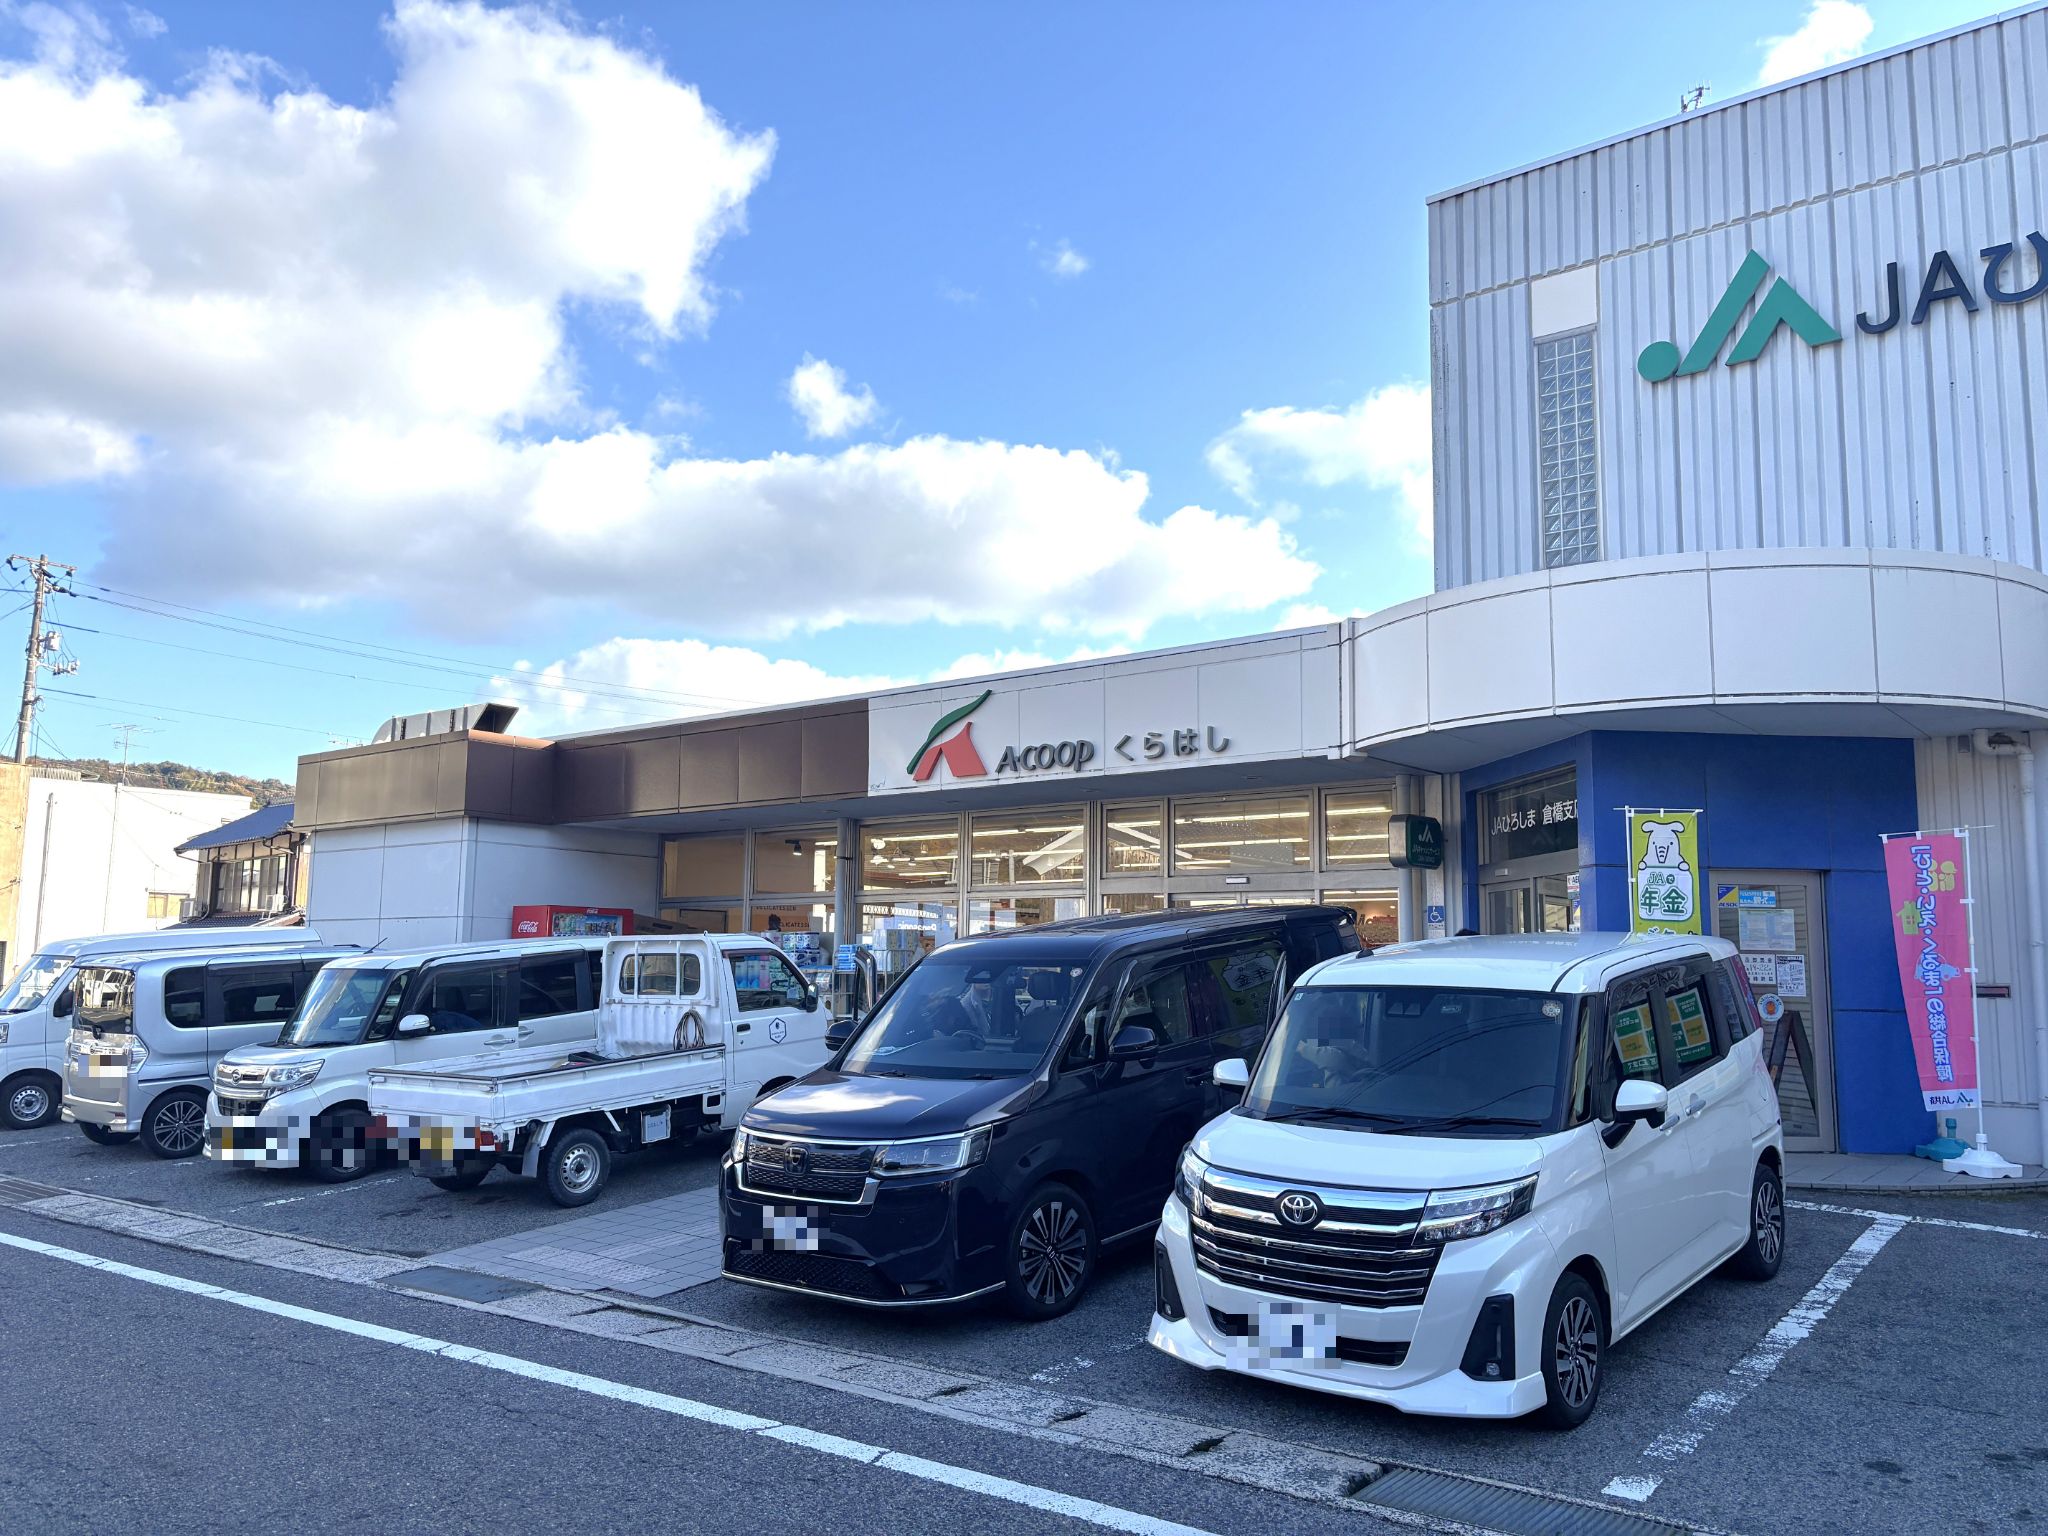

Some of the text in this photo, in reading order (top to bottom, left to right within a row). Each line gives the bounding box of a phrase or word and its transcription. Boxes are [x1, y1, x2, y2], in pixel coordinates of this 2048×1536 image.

[1113, 725, 1230, 762] くらはし
[1491, 809, 1536, 835] JAひろしま
[1640, 886, 1688, 915] 年金
